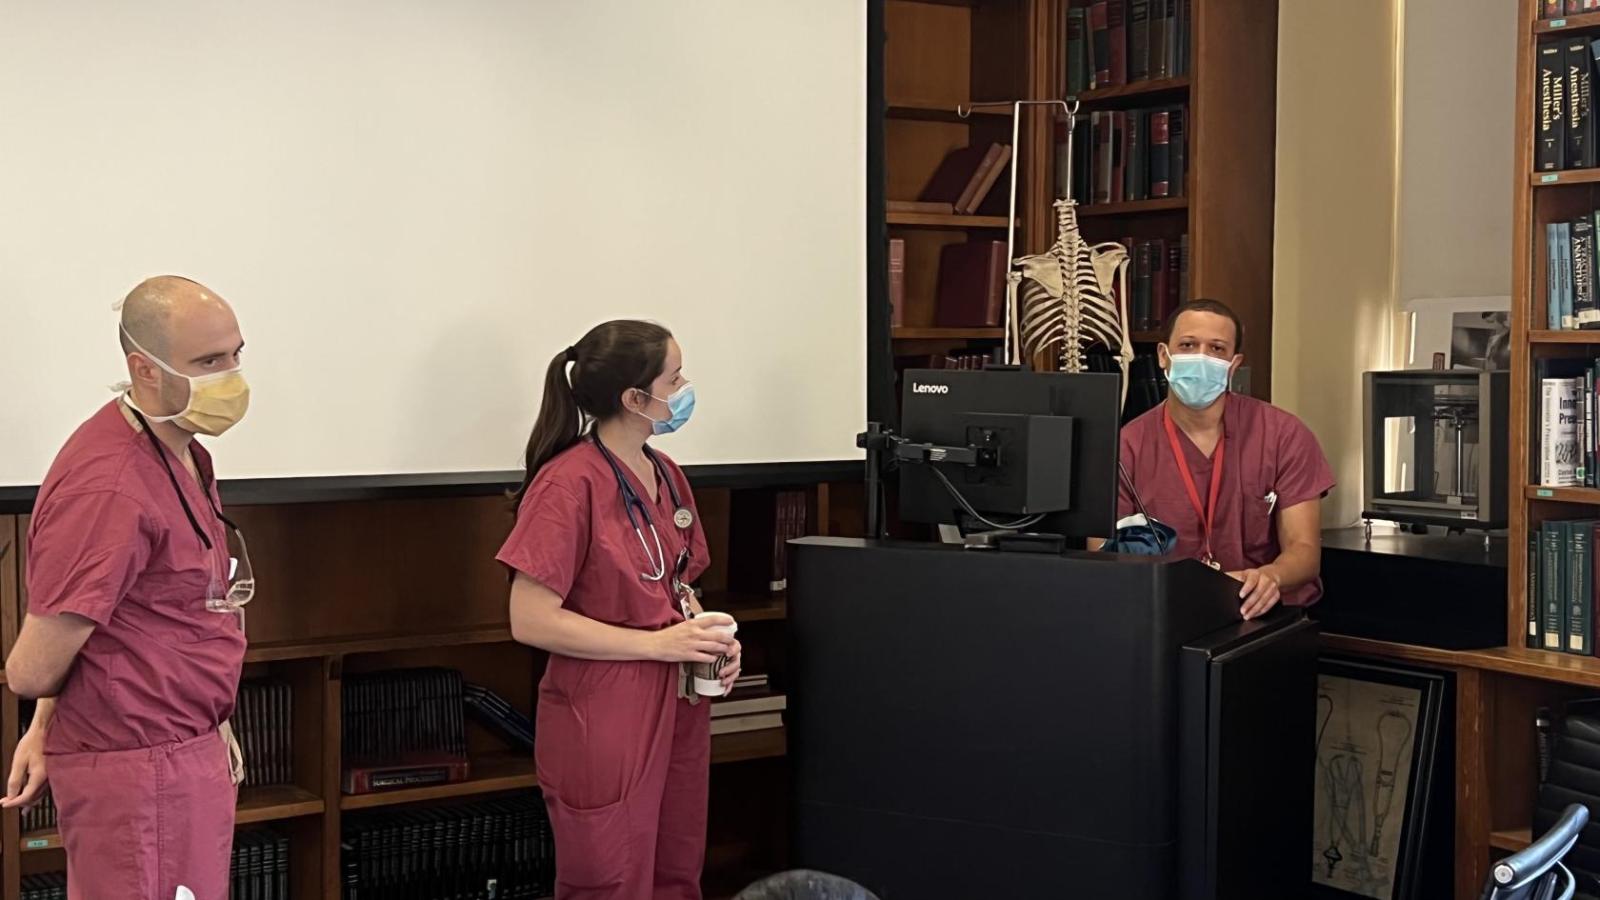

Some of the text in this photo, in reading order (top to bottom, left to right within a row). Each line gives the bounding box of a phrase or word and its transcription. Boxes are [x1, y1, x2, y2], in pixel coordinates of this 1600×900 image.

[1542, 68, 1552, 131] Anesthesia
[1553, 76, 1563, 120] Miller's
[1570, 65, 1581, 129] Anesthesia
[1580, 72, 1590, 118] Miller's
[912, 382, 949, 394] Lenovo
